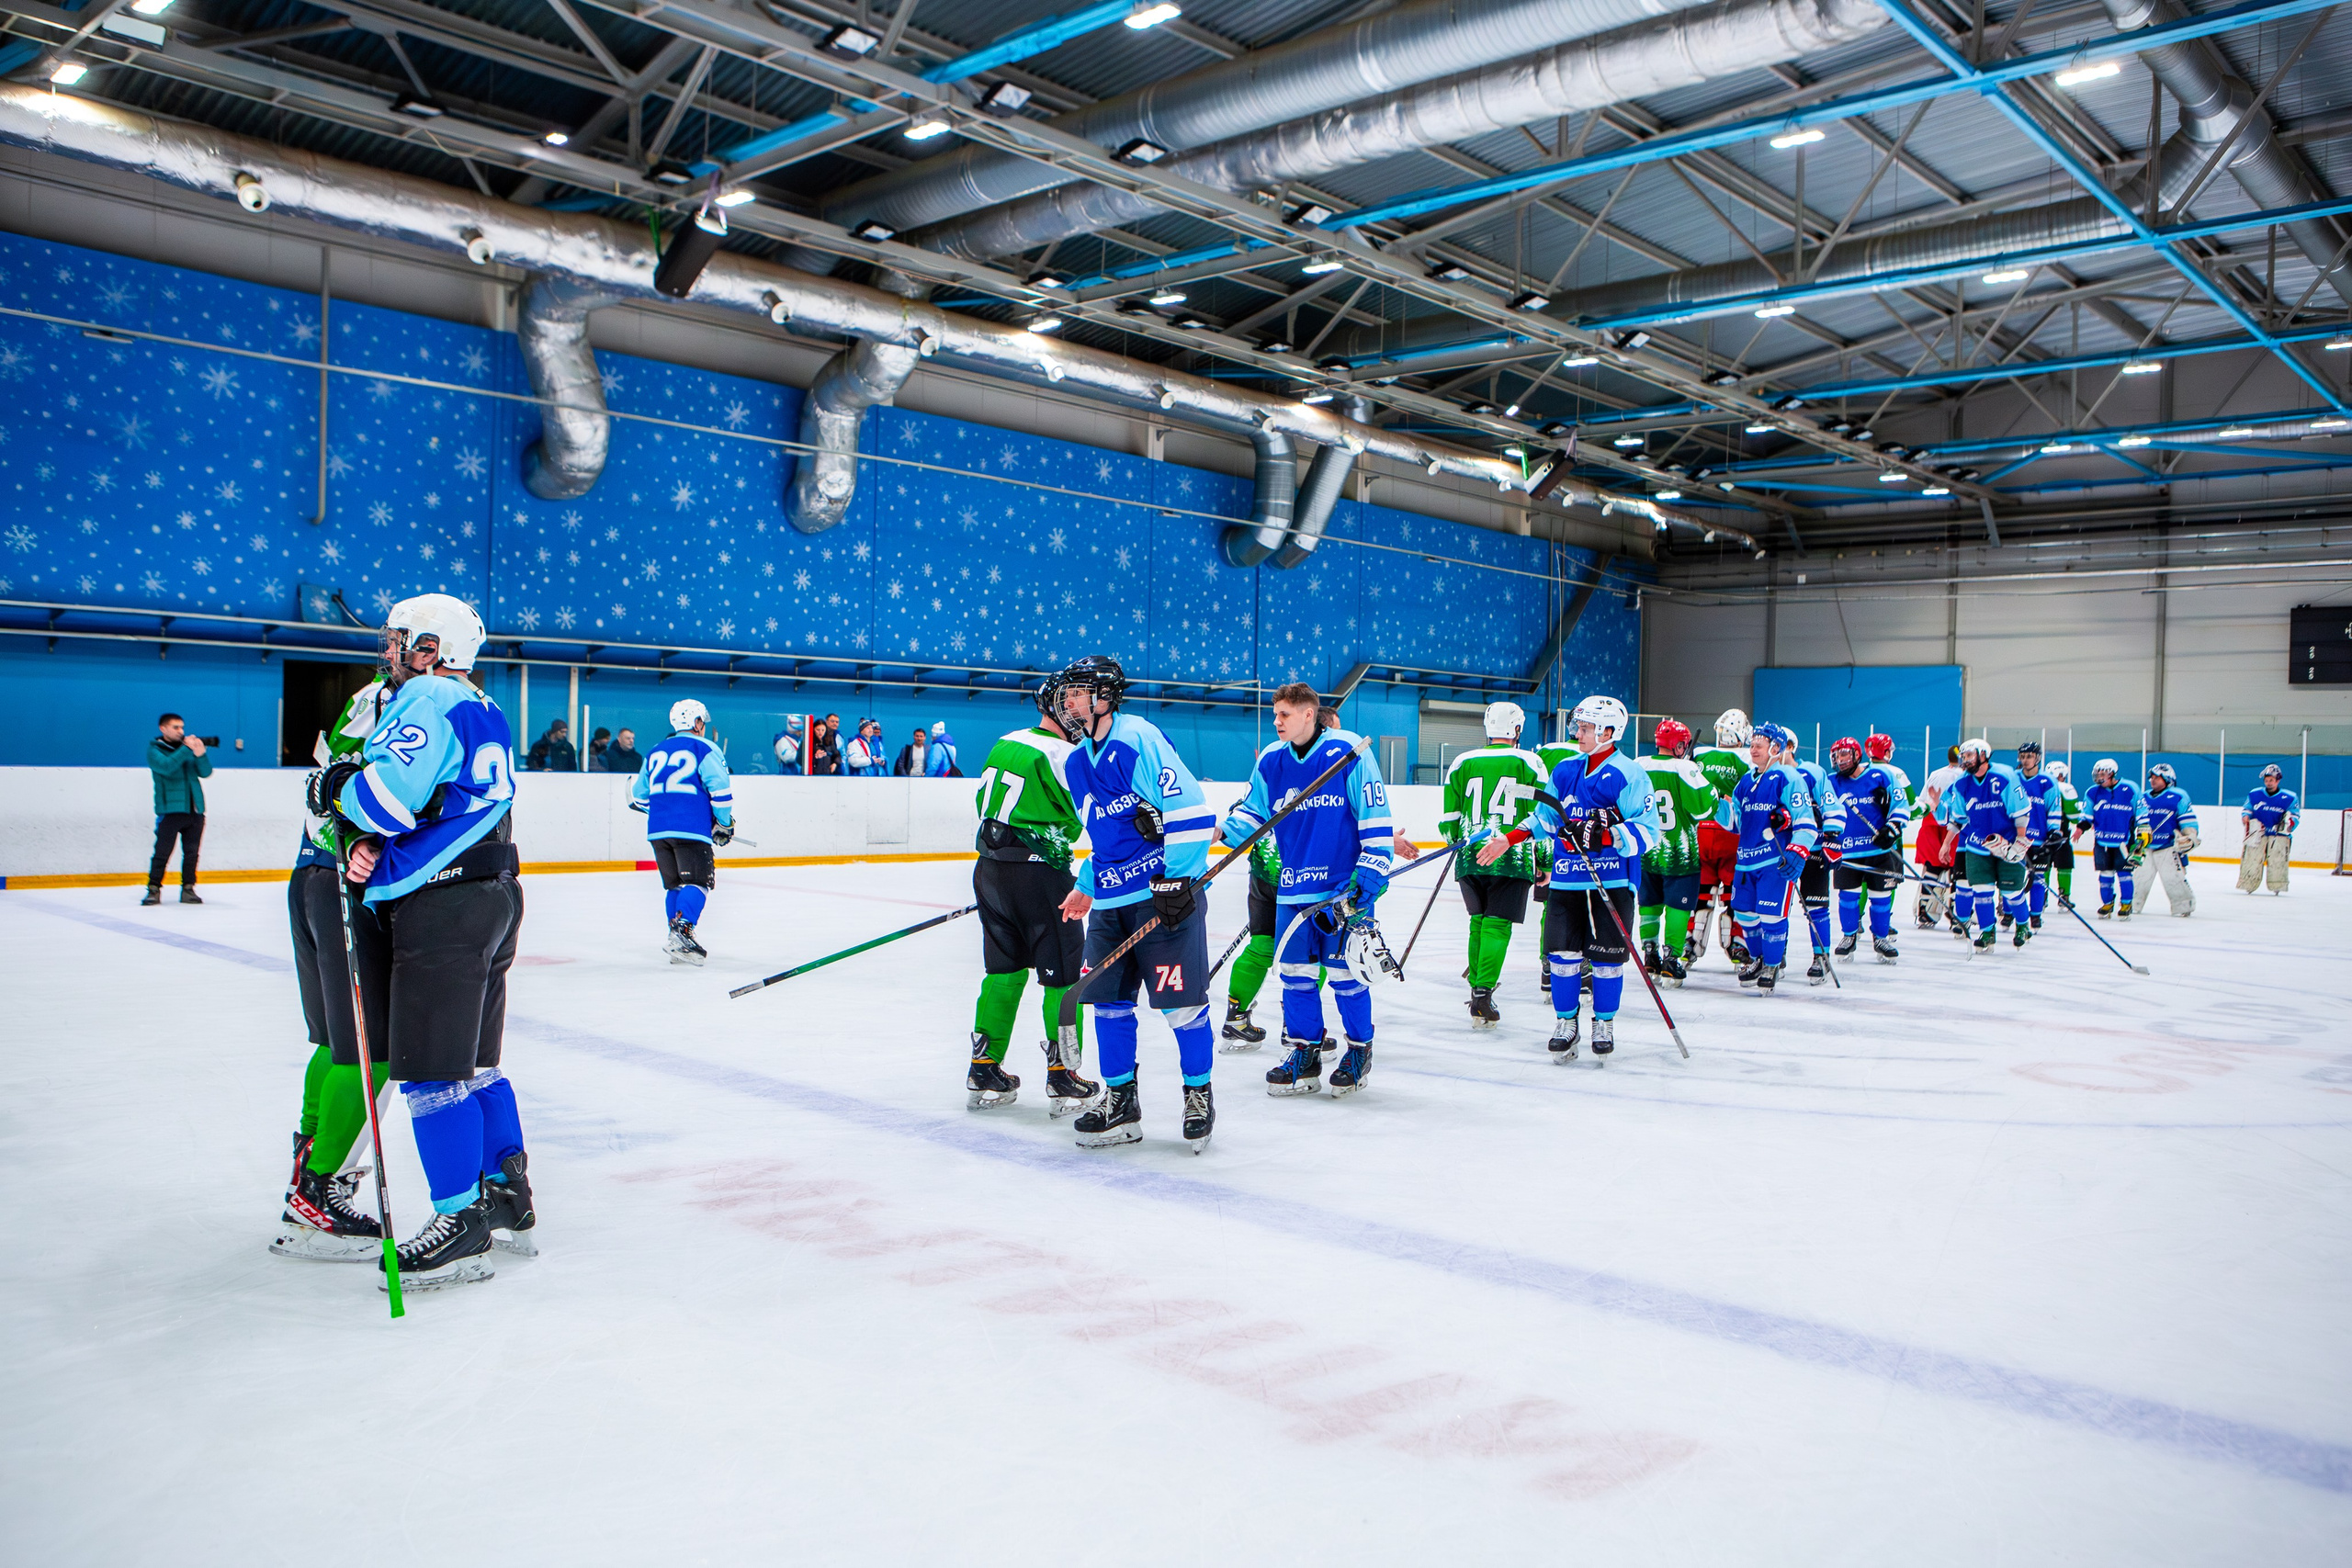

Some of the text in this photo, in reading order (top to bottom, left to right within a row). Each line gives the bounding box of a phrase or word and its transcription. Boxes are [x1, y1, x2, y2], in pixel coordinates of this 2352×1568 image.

[649, 750, 697, 795] 22
[976, 765, 1025, 826] 17
[1363, 781, 1385, 807] 19
[1465, 776, 1517, 825] 14
[1583, 819, 1595, 849] AUER
[1141, 846, 1164, 860] КОМПА
[1359, 854, 1390, 873] AUER
[426, 867, 463, 884] UER
[1124, 855, 1165, 882] АСТРУ
[1155, 964, 1184, 993] 74
[290, 1194, 333, 1230] CCM
